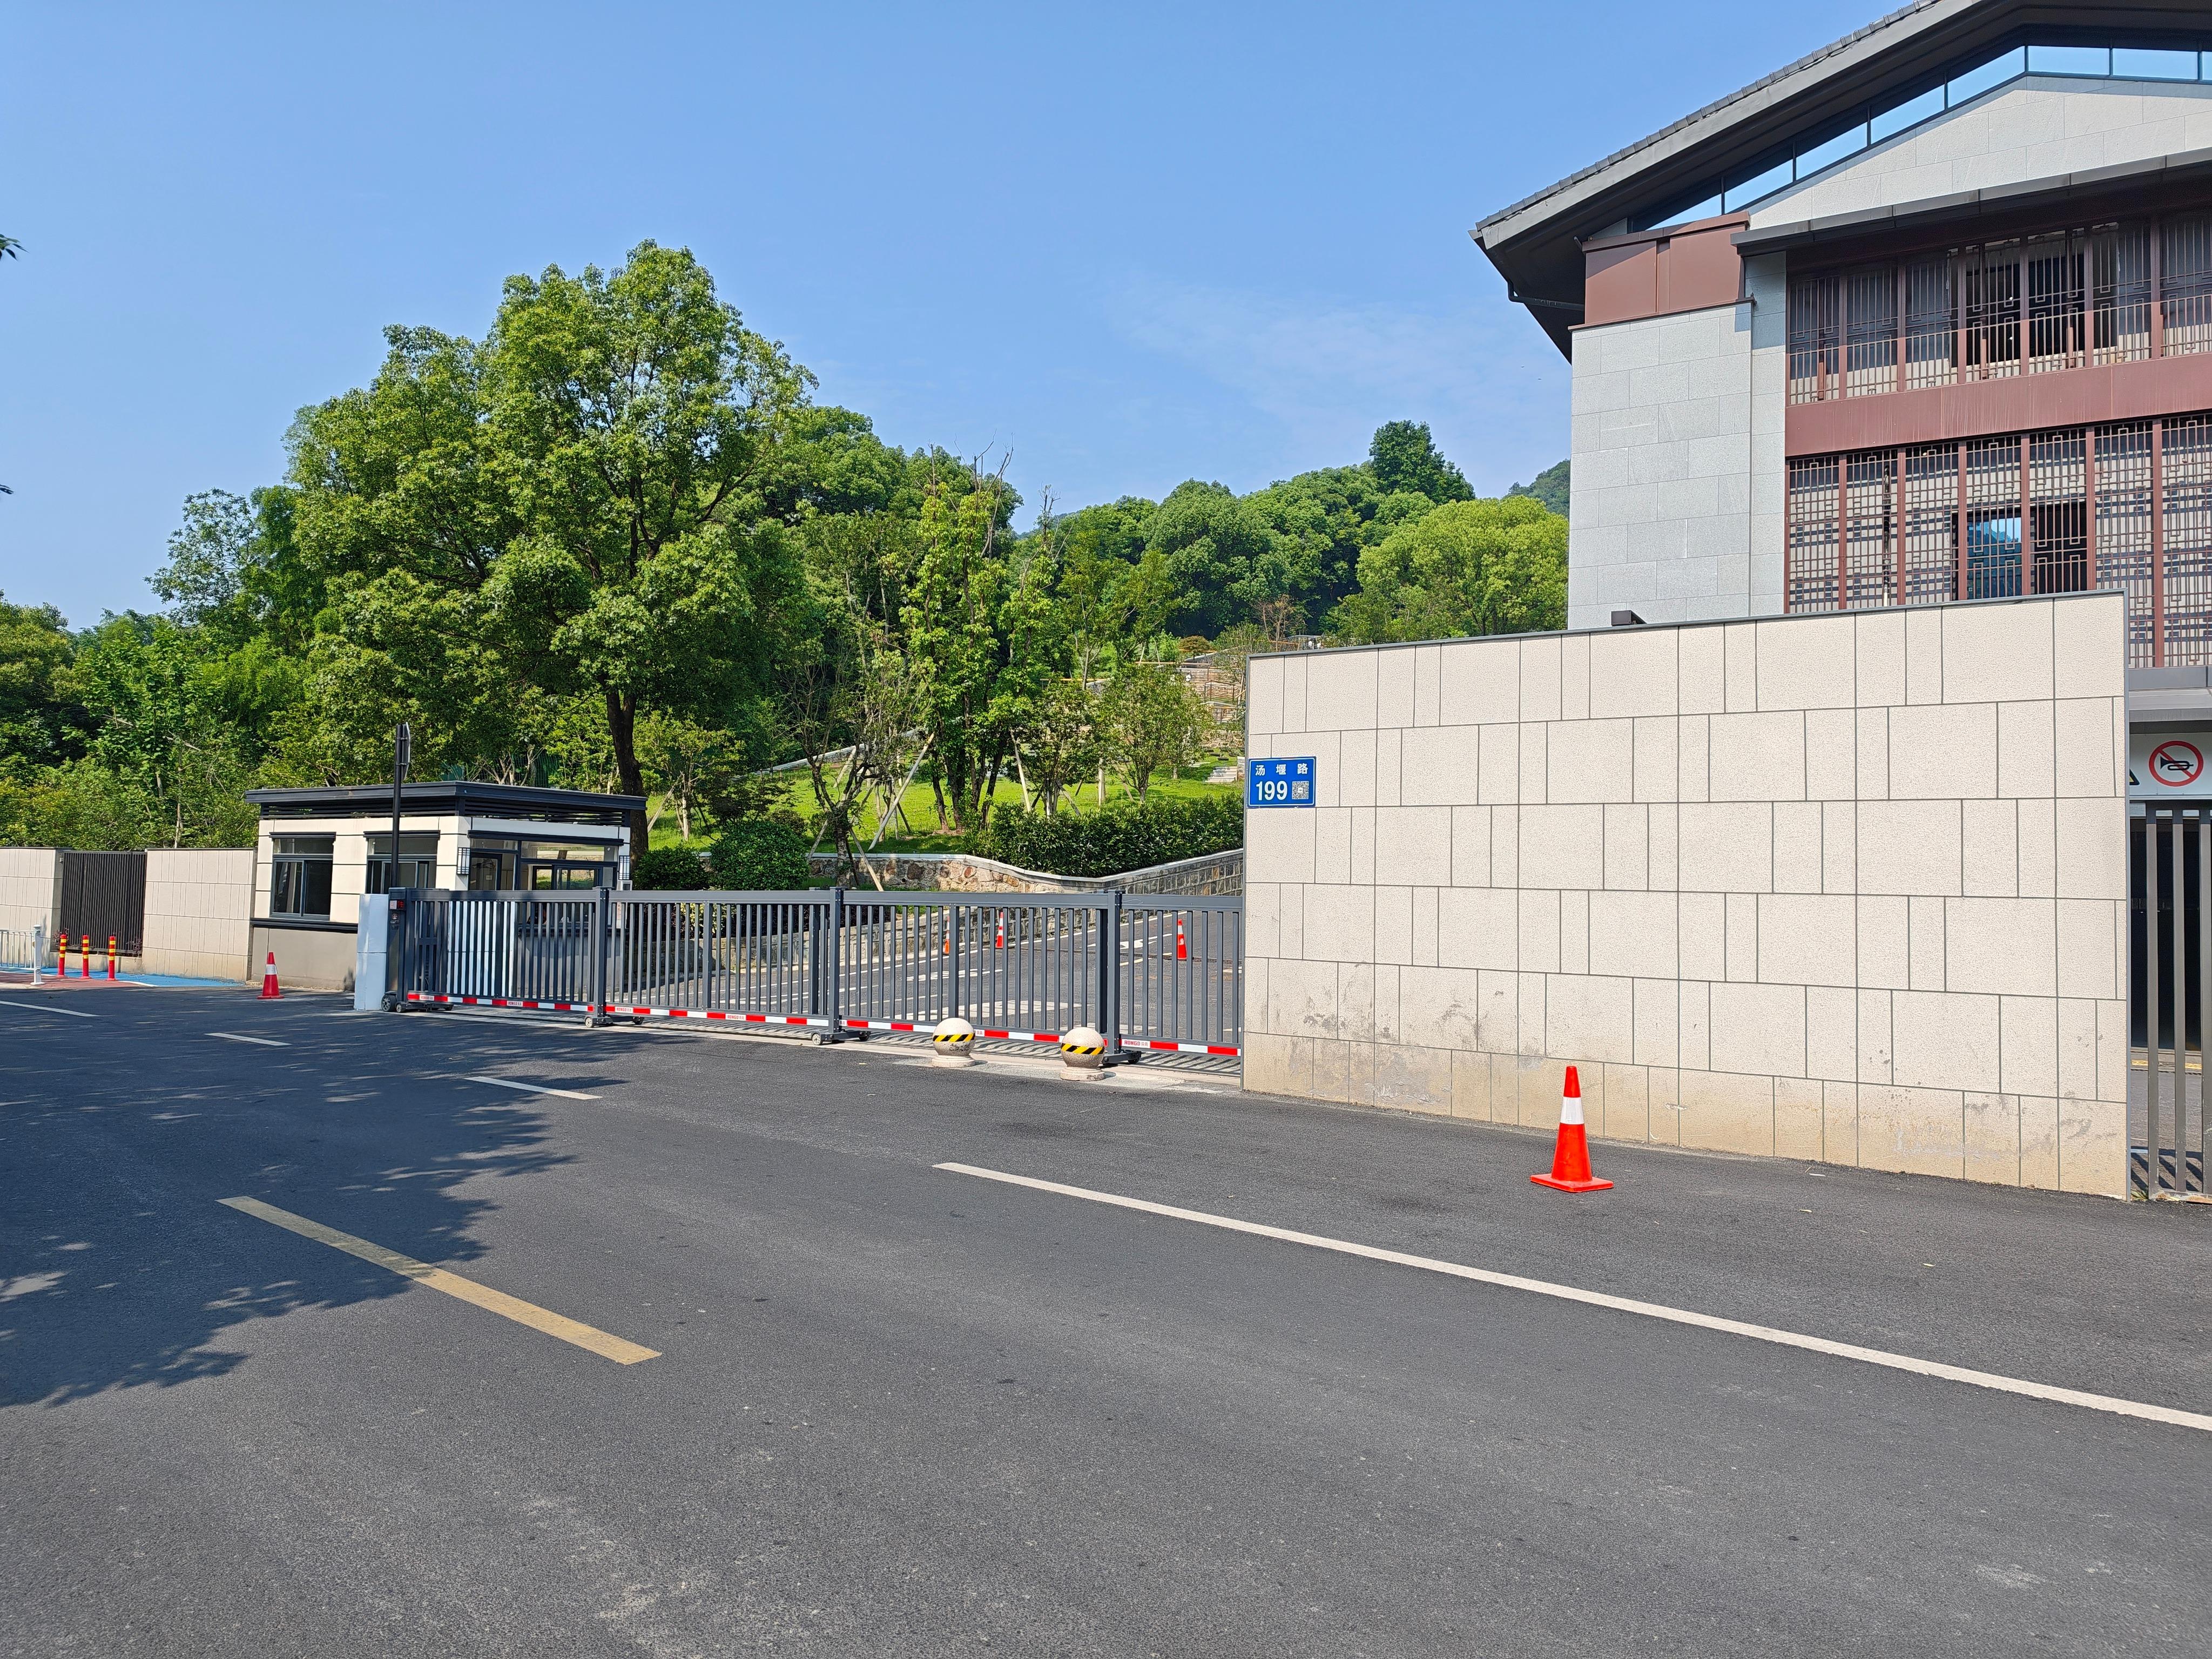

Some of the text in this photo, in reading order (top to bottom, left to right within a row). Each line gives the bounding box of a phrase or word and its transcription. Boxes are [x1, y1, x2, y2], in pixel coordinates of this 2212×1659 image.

[1255, 763, 1309, 776] 汤堰路
[1256, 780, 1288, 801] 199
